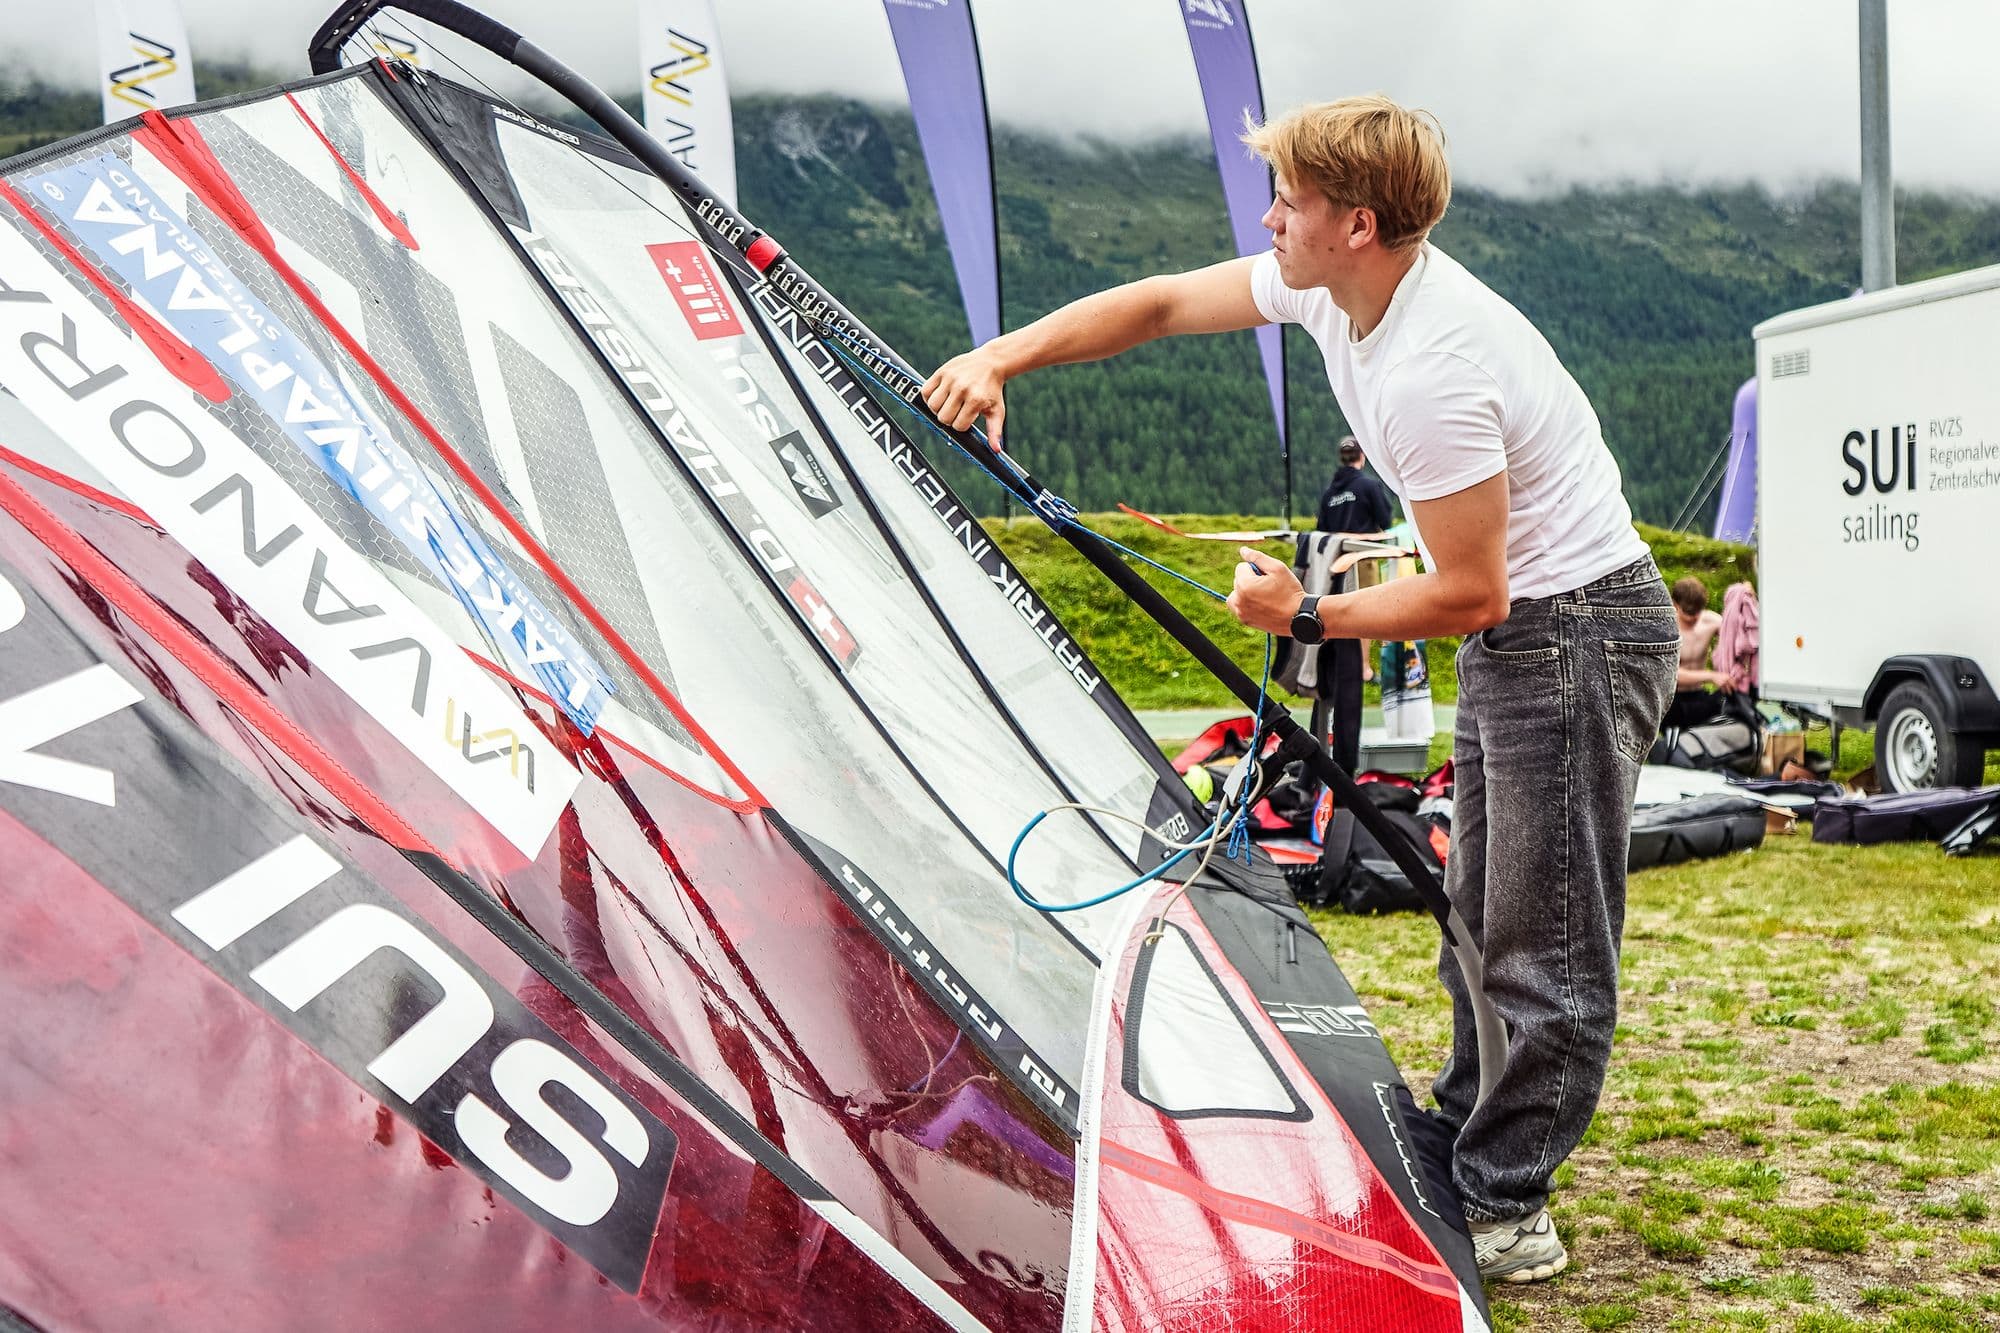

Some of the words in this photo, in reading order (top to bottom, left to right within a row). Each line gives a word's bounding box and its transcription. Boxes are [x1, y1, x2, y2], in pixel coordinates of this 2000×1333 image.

[109, 169, 281, 341] SWITZERLAND
[692, 256, 730, 321] dreiplus.ch
[73, 177, 441, 541] SILVAPLANA
[533, 247, 740, 497] HAUSER
[749, 277, 992, 562] INTERNATIONAL
[1929, 417, 1963, 438] RVZS
[482, 552, 567, 645] MORITZ
[749, 513, 794, 573] D.
[1842, 503, 1920, 552] sailing
[439, 541, 594, 711] LAKE
[989, 564, 1100, 696] PATRIK
[171, 833, 650, 1227] SUI
